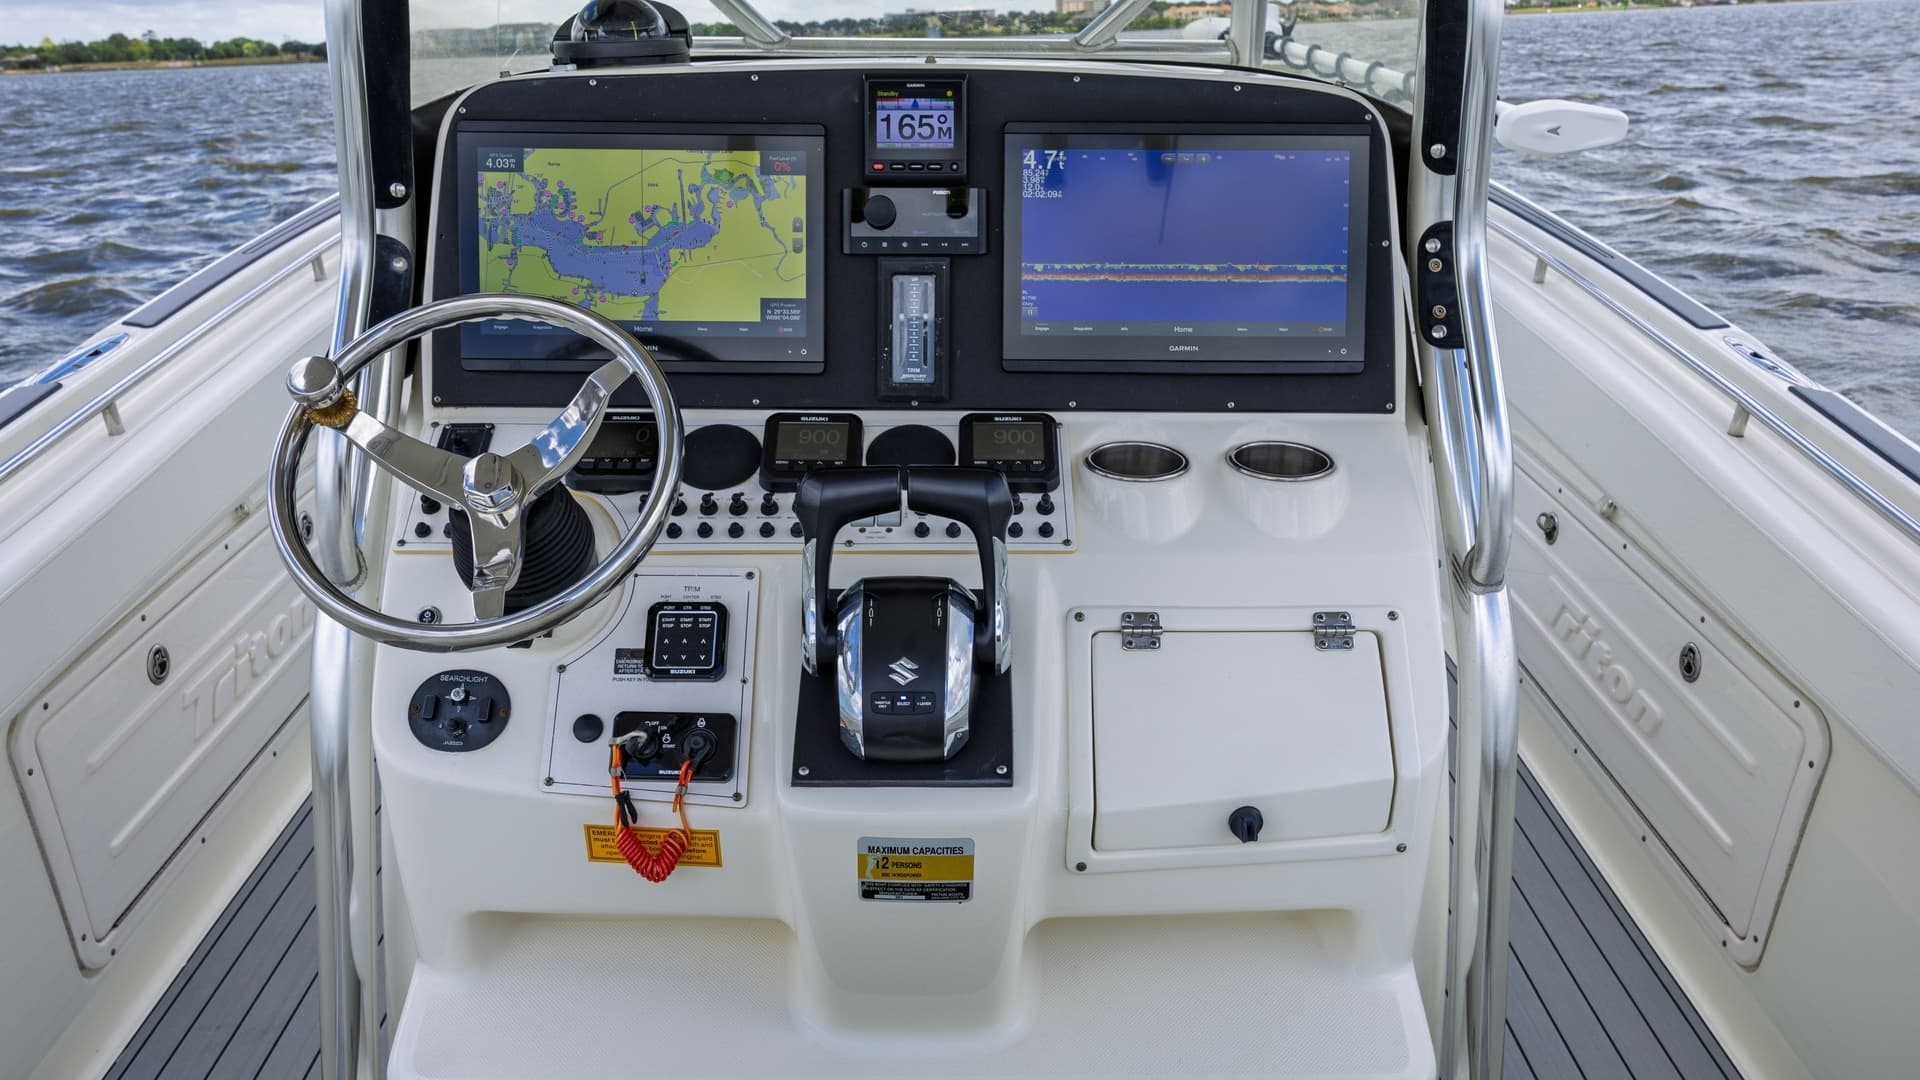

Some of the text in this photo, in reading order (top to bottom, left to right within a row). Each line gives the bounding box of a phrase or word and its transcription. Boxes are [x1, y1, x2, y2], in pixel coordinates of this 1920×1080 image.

[486, 158, 509, 169] 4.03
[633, 325, 653, 333] Home
[1173, 325, 1193, 333] Home
[800, 429, 841, 444] 900
[993, 429, 1036, 444] 900
[684, 585, 701, 593] TRIM
[440, 674, 489, 684] SEARCHLIGHT
[867, 845, 964, 855] MAXIMUM CAPACITIES
[891, 861, 922, 869] PERSONS
